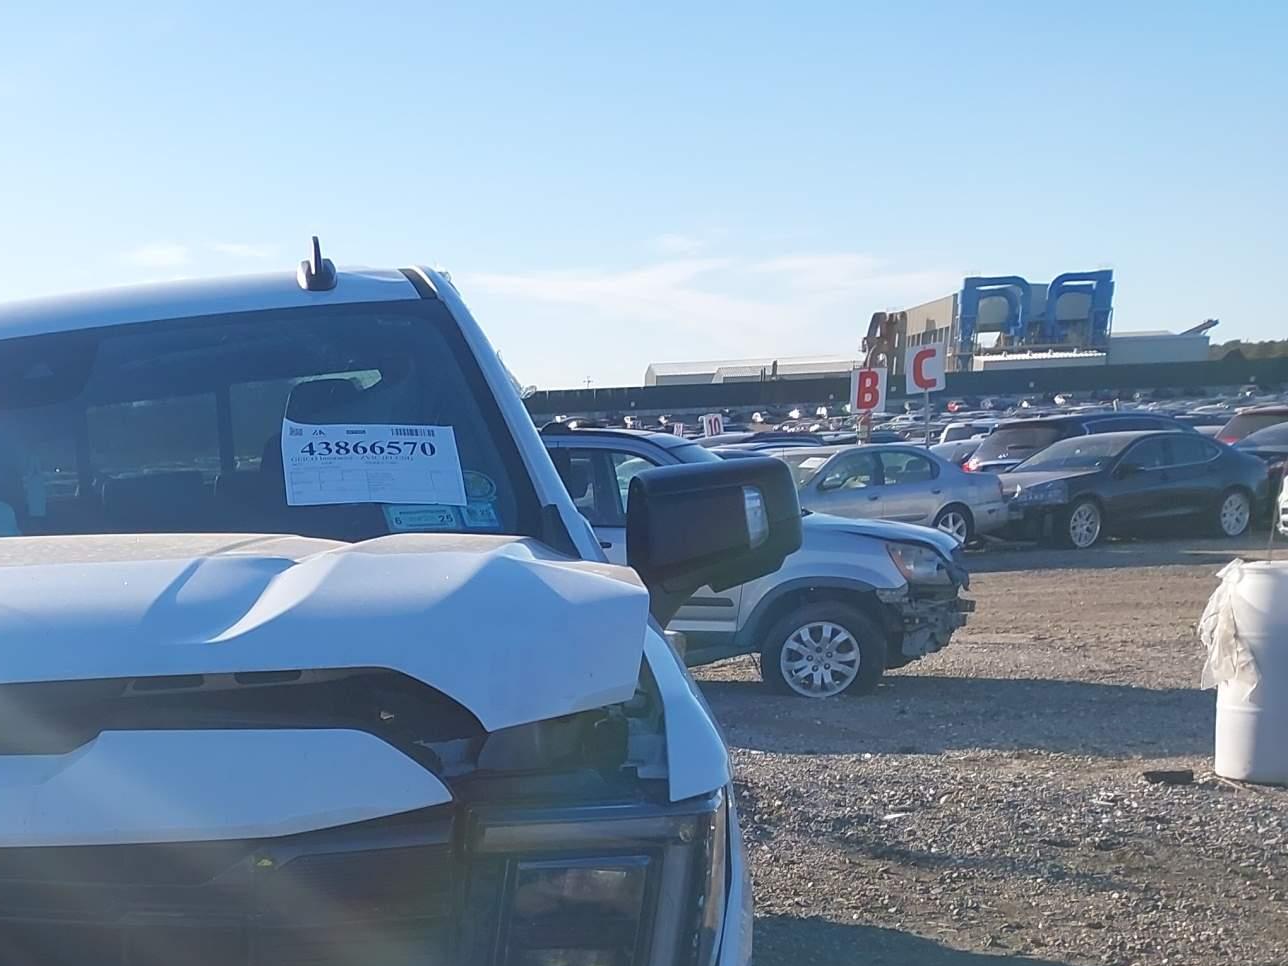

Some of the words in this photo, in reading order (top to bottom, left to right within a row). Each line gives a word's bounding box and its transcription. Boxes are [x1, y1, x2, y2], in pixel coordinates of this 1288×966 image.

[913, 348, 937, 389] C
[856, 371, 880, 410] B
[300, 439, 437, 457] 43866570
